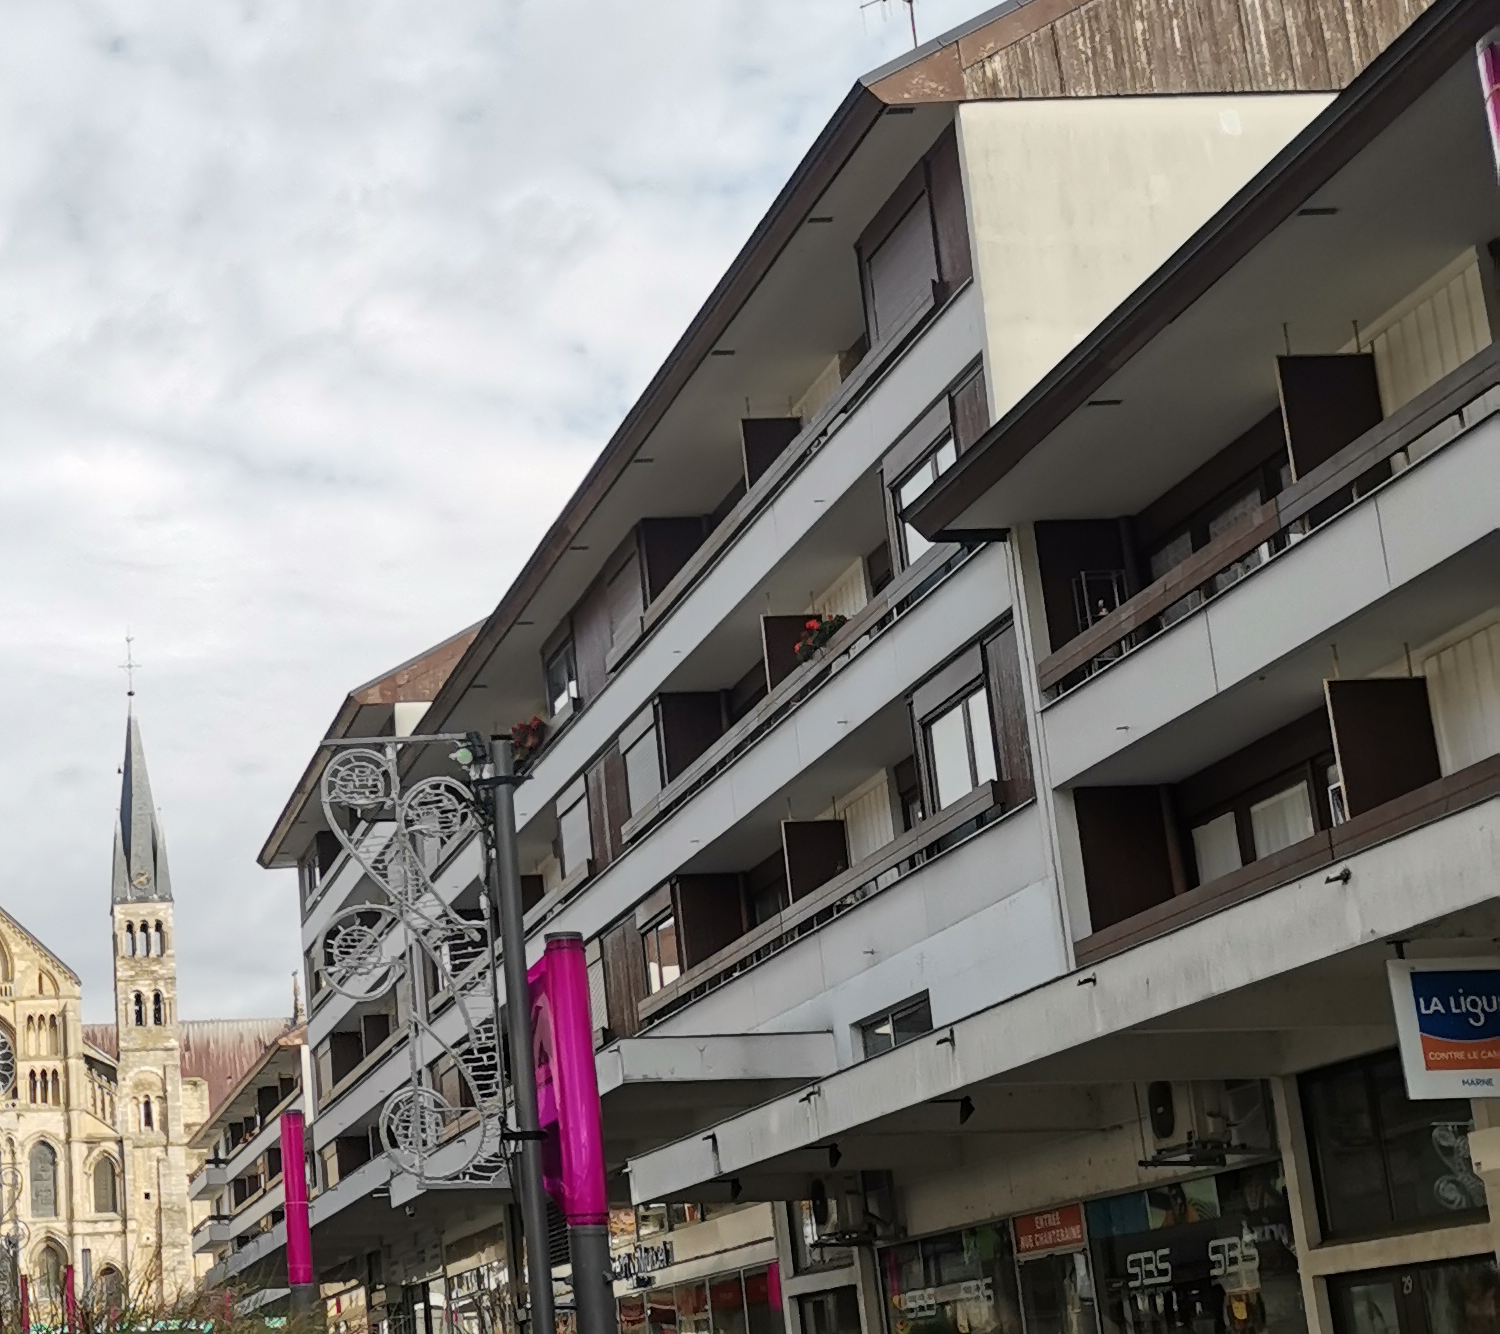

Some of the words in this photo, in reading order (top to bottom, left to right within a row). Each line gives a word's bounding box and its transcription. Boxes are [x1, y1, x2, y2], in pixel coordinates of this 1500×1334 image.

[1419, 996, 1447, 1015] LA
[1428, 1050, 1466, 1061] CONTRE
[1467, 1051, 1479, 1060] LE
[1461, 1077, 1494, 1087] MARNE
